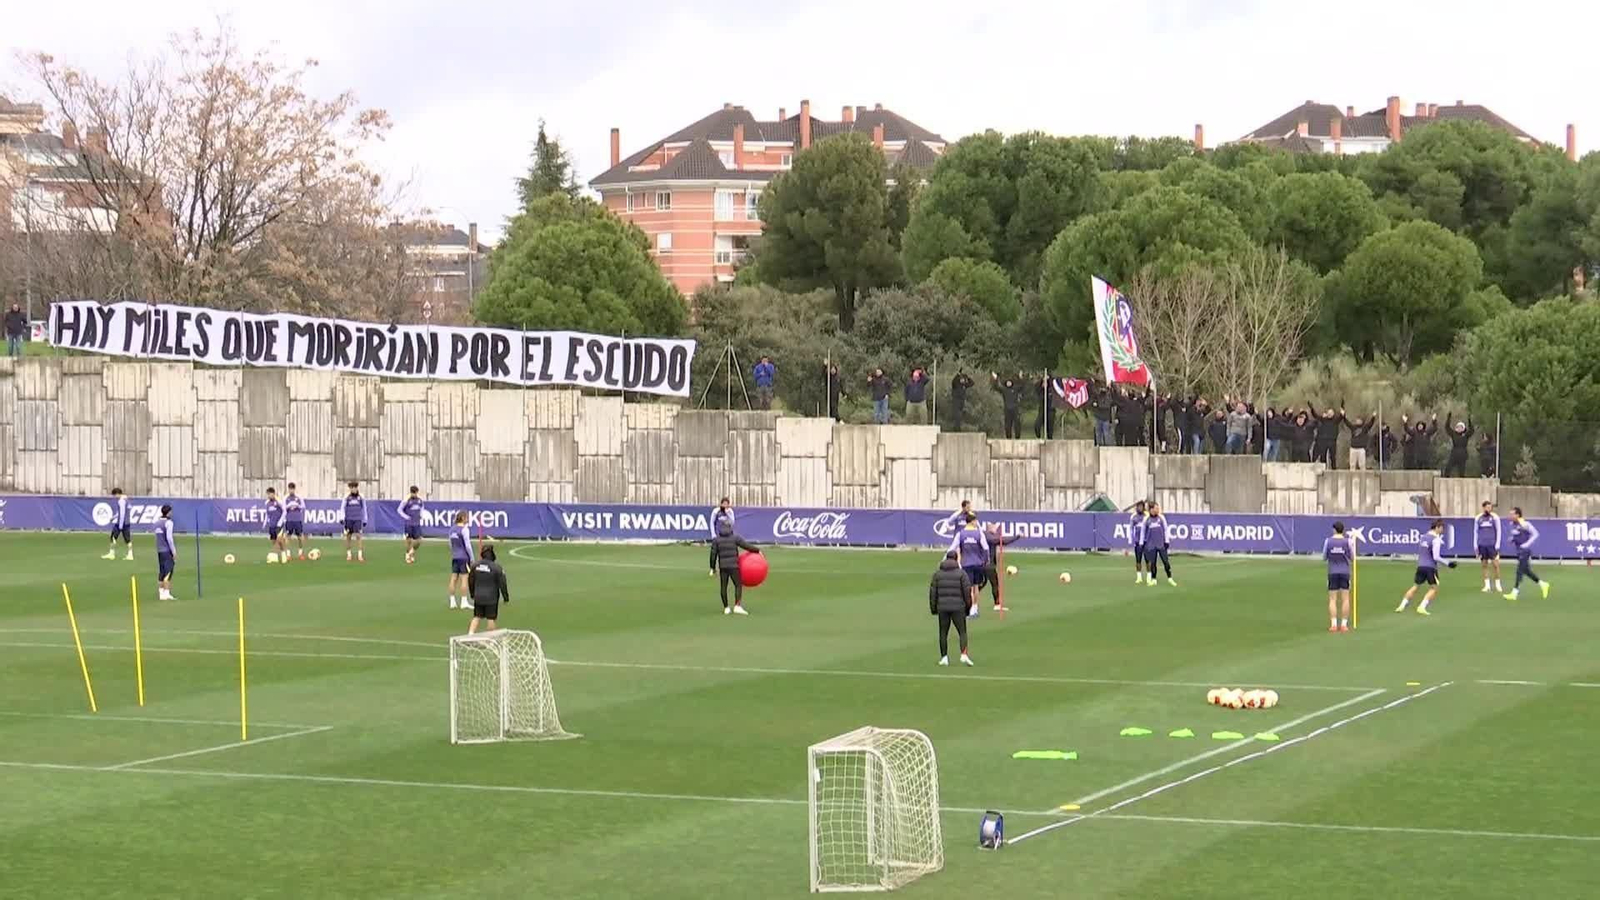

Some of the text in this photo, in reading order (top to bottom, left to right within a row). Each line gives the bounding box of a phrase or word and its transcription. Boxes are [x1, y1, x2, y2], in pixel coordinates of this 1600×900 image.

[53, 305, 115, 349] HAY
[222, 317, 279, 362] QUE
[449, 332, 512, 377] POR
[520, 336, 553, 381] EL
[564, 337, 688, 391] ESCUDO
[304, 510, 342, 523] MAD
[434, 509, 509, 527] krken
[562, 512, 709, 531] VISIT RWANDA
[1113, 524, 1188, 539] ATCO
[1207, 525, 1274, 541] MADRID
